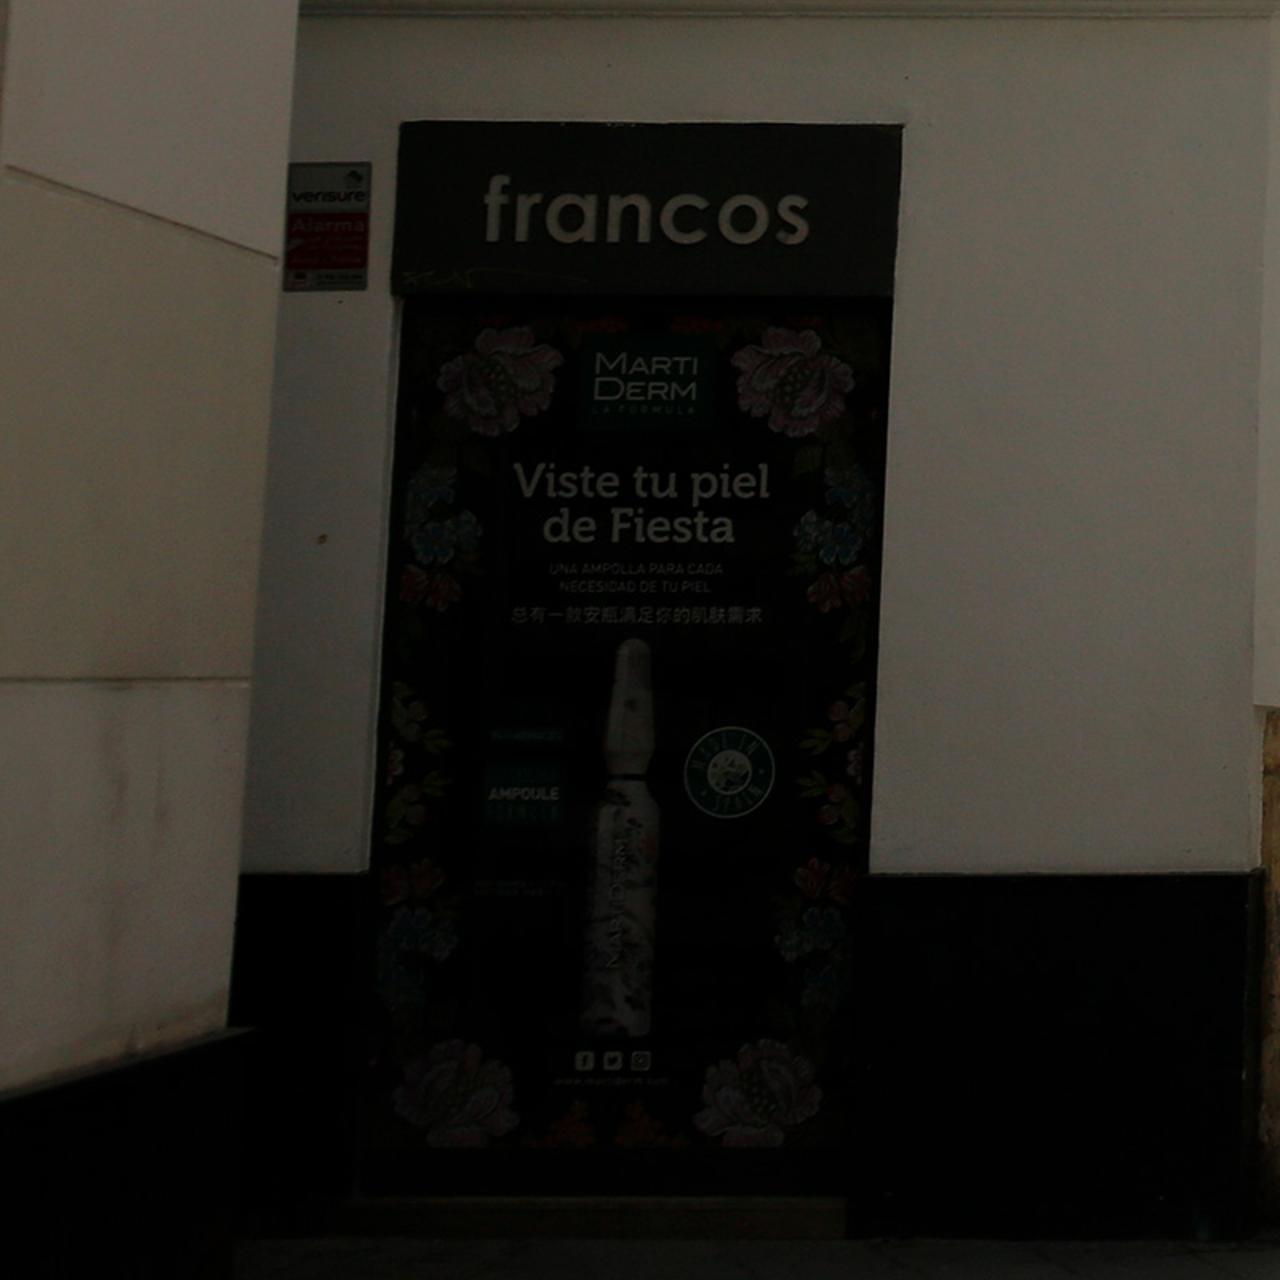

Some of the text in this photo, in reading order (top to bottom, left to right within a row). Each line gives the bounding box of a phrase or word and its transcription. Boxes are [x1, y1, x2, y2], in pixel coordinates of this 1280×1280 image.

[291, 190, 367, 203] verisure
[481, 172, 812, 247] francos
[291, 216, 365, 233] Alarma
[594, 351, 699, 376] MARTI
[593, 376, 697, 402] DERM
[511, 461, 771, 509] Viste tu piel
[541, 505, 736, 545] de Fiesta
[547, 562, 724, 577] UNA AMPOLLA PARA CADA
[559, 580, 711, 593] NECESIDAD DE TU PIEL
[488, 786, 560, 801] AMPOULE
